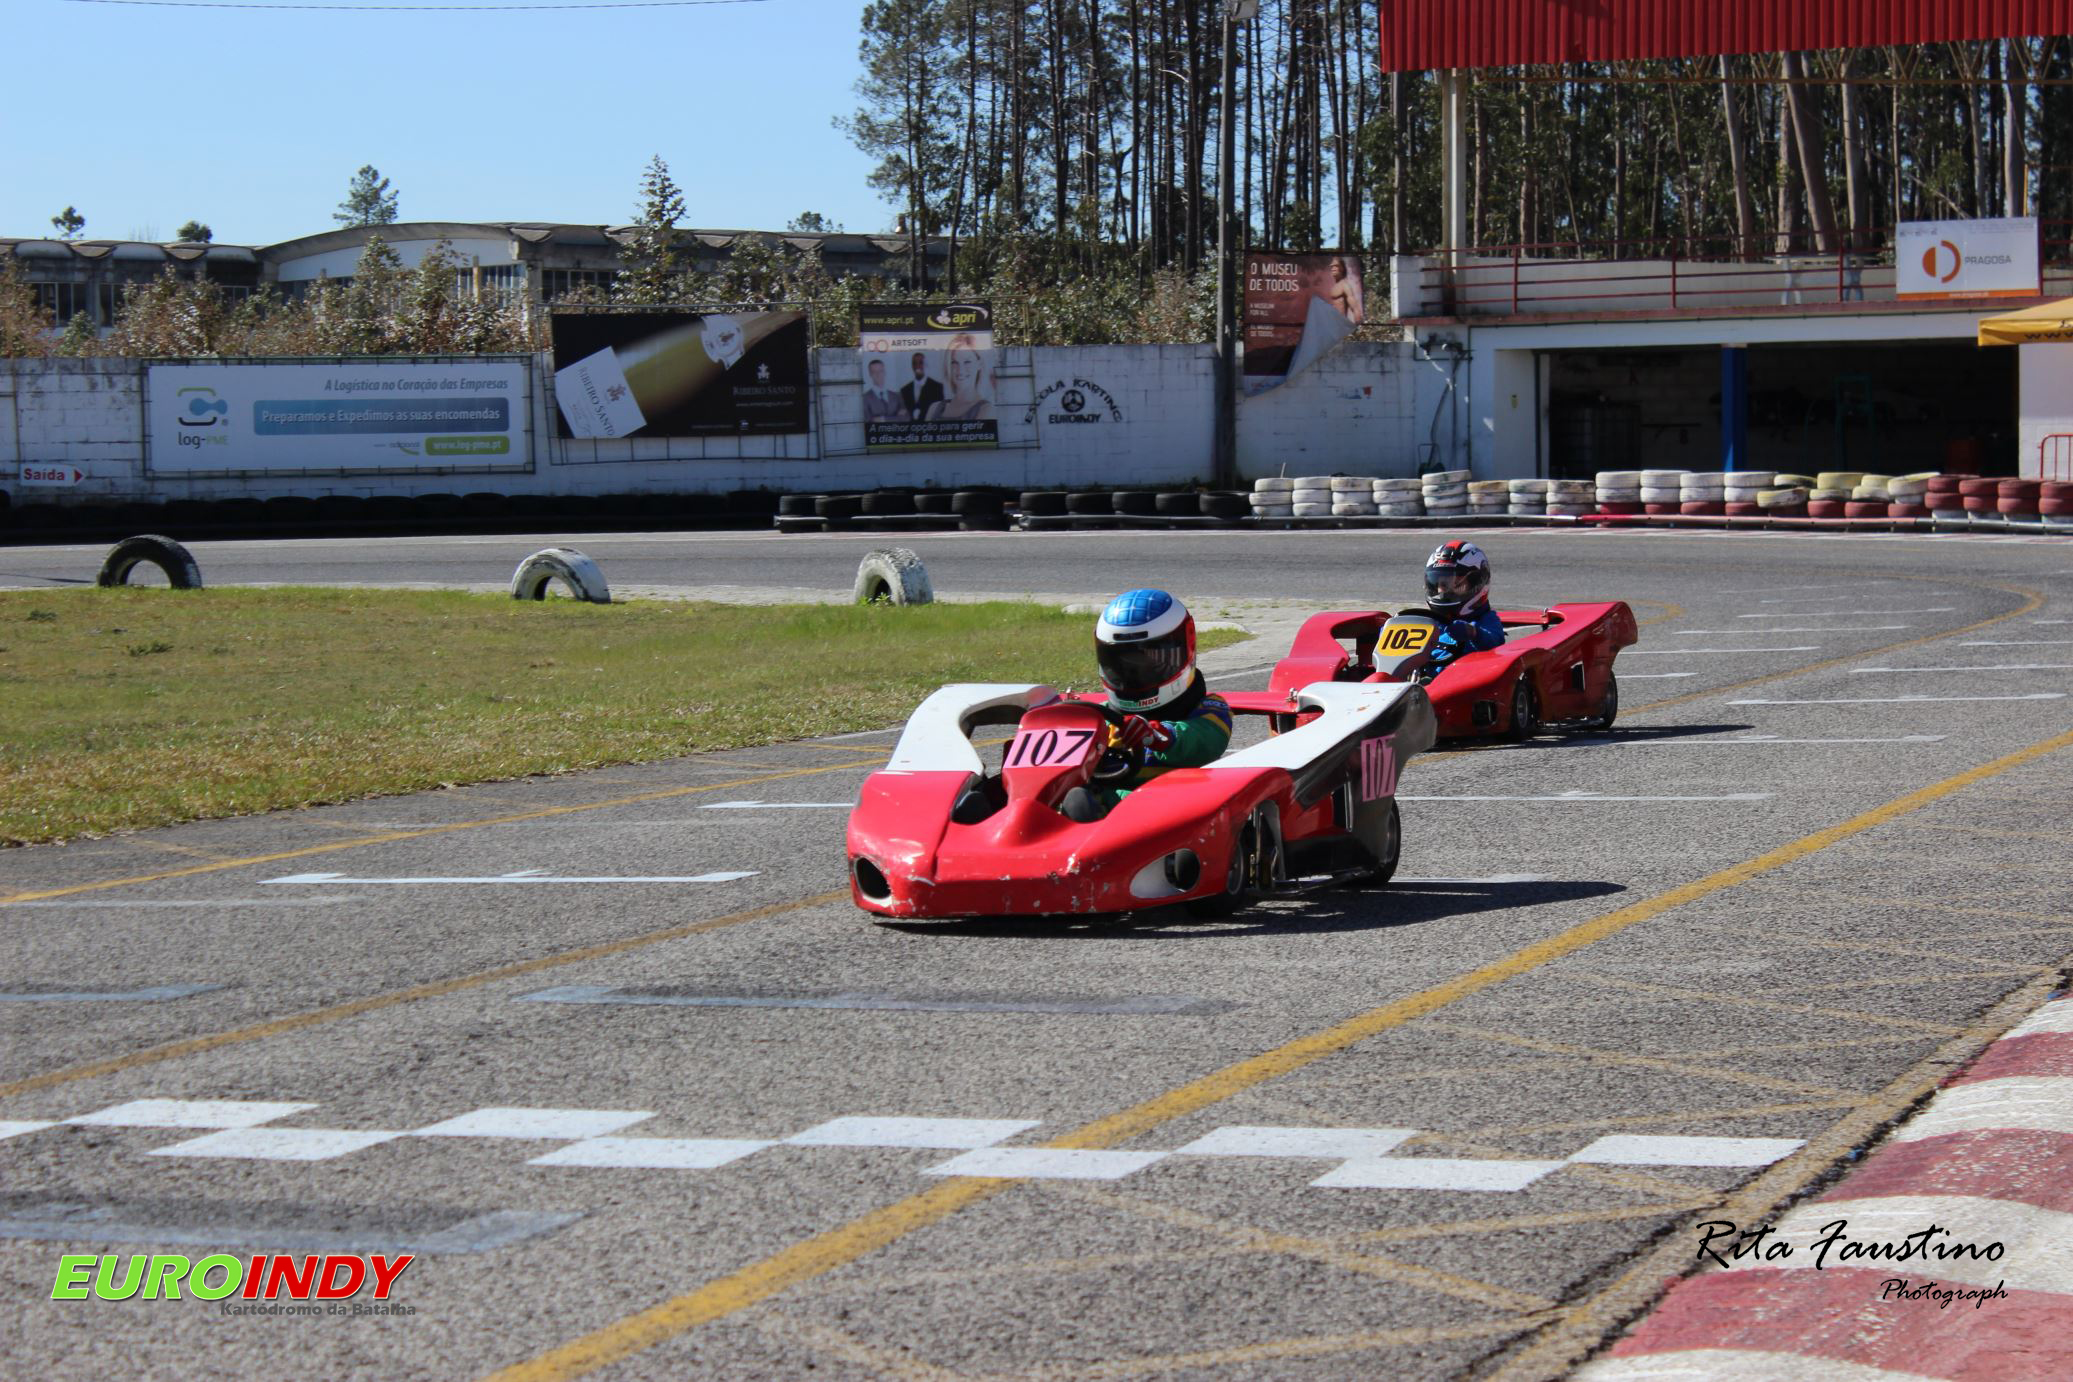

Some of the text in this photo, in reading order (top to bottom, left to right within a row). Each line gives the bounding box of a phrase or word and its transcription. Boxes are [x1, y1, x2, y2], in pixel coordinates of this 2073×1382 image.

[1964, 255, 2012, 265] PRAGOSA
[1250, 262, 1298, 276] O MUSEU
[1249, 279, 1300, 292] DE TODOS
[863, 316, 914, 326] www.apri.pt
[952, 312, 976, 325] apri
[891, 338, 928, 347] ARTSOFT
[325, 377, 509, 394] A Logística no Coração das Empresas
[1072, 378, 1122, 423] KARTING
[262, 407, 500, 425] Preparamos e Expedimos as suas encomendas
[869, 423, 877, 433] A
[878, 423, 909, 432] melhor
[961, 421, 985, 432] gerir
[870, 432, 995, 443] o dia-a-dia da sua empresa
[24, 468, 65, 480] Saída
[1381, 628, 1428, 650] 102
[1011, 729, 1095, 767] 107
